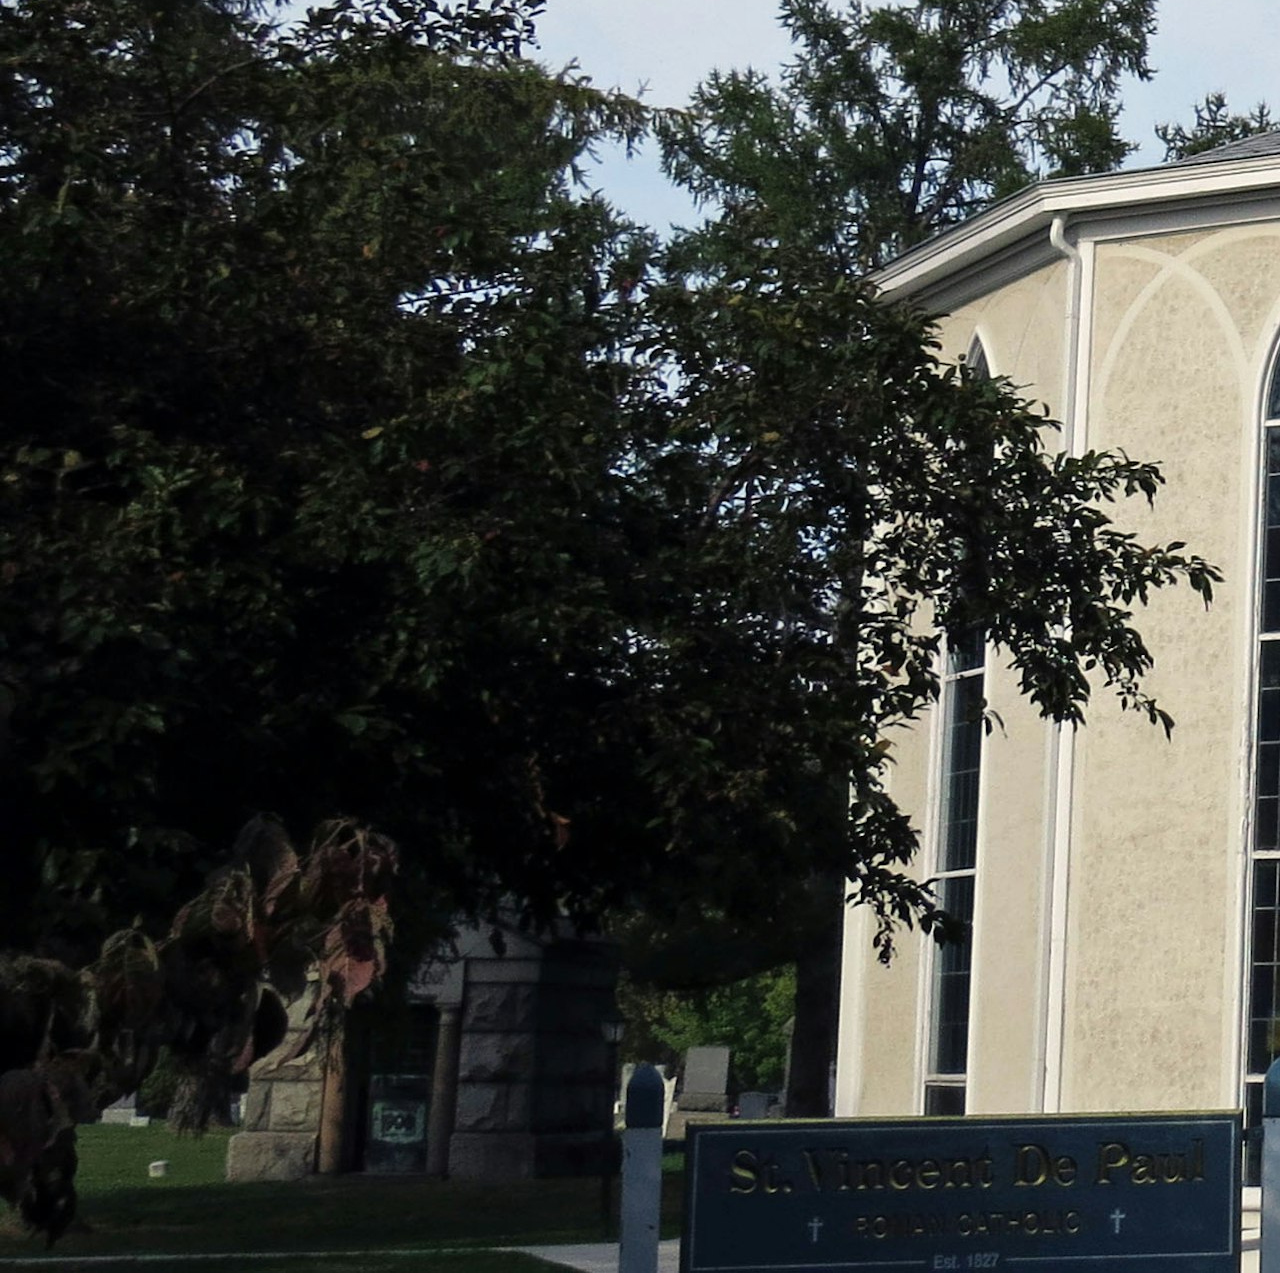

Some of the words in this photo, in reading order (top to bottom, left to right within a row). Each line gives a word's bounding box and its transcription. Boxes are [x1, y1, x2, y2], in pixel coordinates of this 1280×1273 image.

[730, 1149, 792, 1193] St.
[801, 1147, 992, 1192] Vincent
[1011, 1142, 1078, 1187] De
[1096, 1138, 1204, 1185] Paul
[857, 1215, 945, 1239] ROMAN
[958, 1211, 1080, 1236] CATHOLIC
[933, 1254, 961, 1270] Est.
